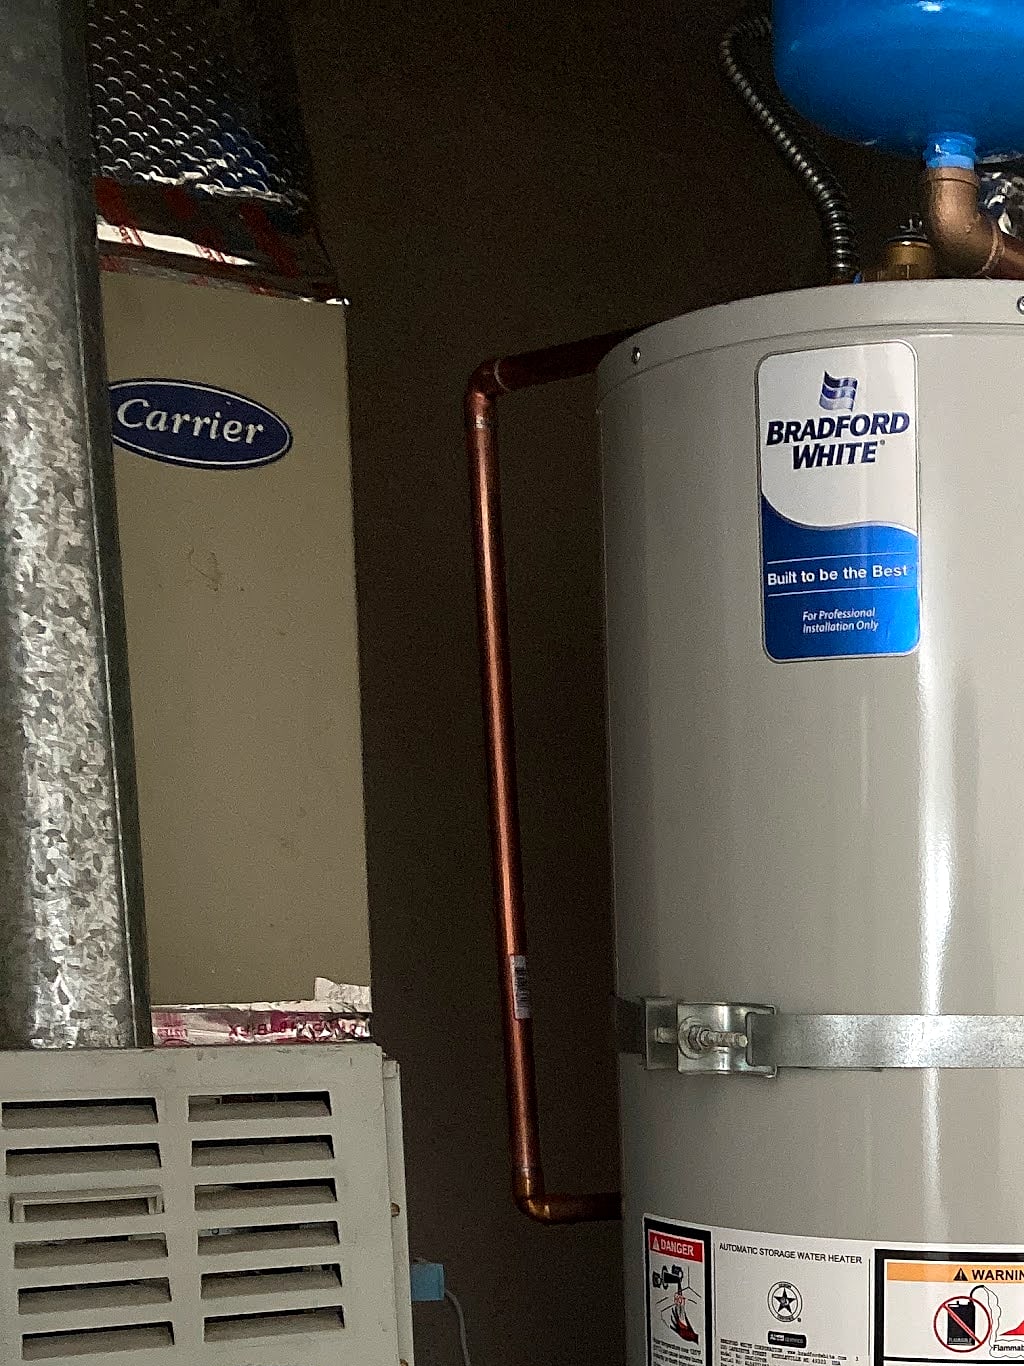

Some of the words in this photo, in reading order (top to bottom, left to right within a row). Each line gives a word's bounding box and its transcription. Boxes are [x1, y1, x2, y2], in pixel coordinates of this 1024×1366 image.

[117, 398, 264, 444] Carrier
[766, 411, 910, 446] BRADFORD
[768, 570, 797, 586] Built
[801, 570, 815, 583] to
[819, 567, 838, 581] be
[842, 564, 867, 579] the
[872, 564, 908, 578] Best
[803, 610, 817, 621] For
[818, 607, 876, 620] Professional
[803, 621, 855, 634] Installation
[856, 620, 879, 633] Only
[660, 1238, 695, 1257] DANGER
[719, 1242, 758, 1256] AUTOMATIC
[759, 1249, 796, 1260] STORAGE
[797, 1252, 827, 1262] WATER
[828, 1254, 862, 1264] HEATER
